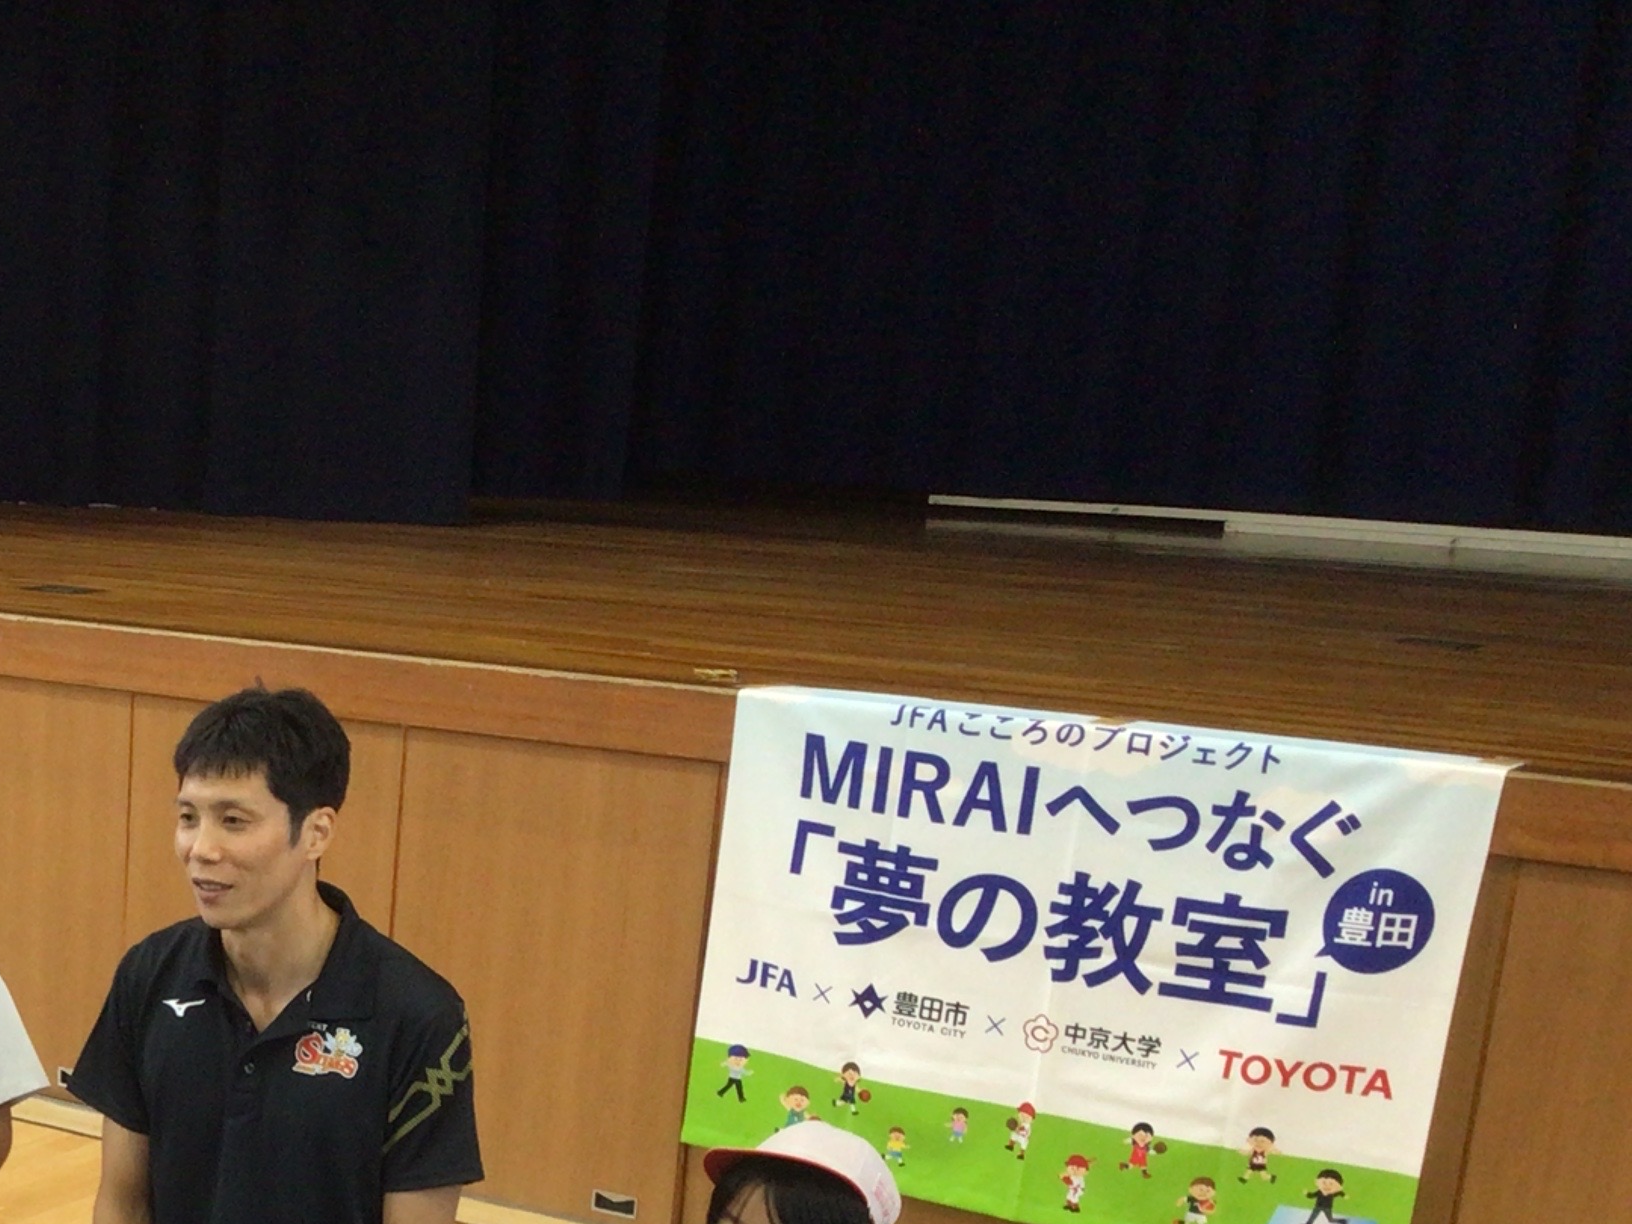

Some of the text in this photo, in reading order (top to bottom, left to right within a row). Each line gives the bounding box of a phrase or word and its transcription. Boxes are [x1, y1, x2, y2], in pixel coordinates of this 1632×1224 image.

[799, 732, 1362, 879] MIRAIへつなぐ
[1369, 881, 1394, 907] in
[788, 819, 1328, 1029] 「夢の教室」
[1333, 907, 1419, 950] 豊田
[735, 958, 798, 998] JFA
[892, 991, 970, 1027] 豊田市
[1064, 1022, 1162, 1058] 中京大学
[1218, 1049, 1394, 1100] TOYOTA
[891, 1016, 966, 1039] TOYOTA CITY
[1061, 1045, 1157, 1070] CHUKYO UNIVERSITY
